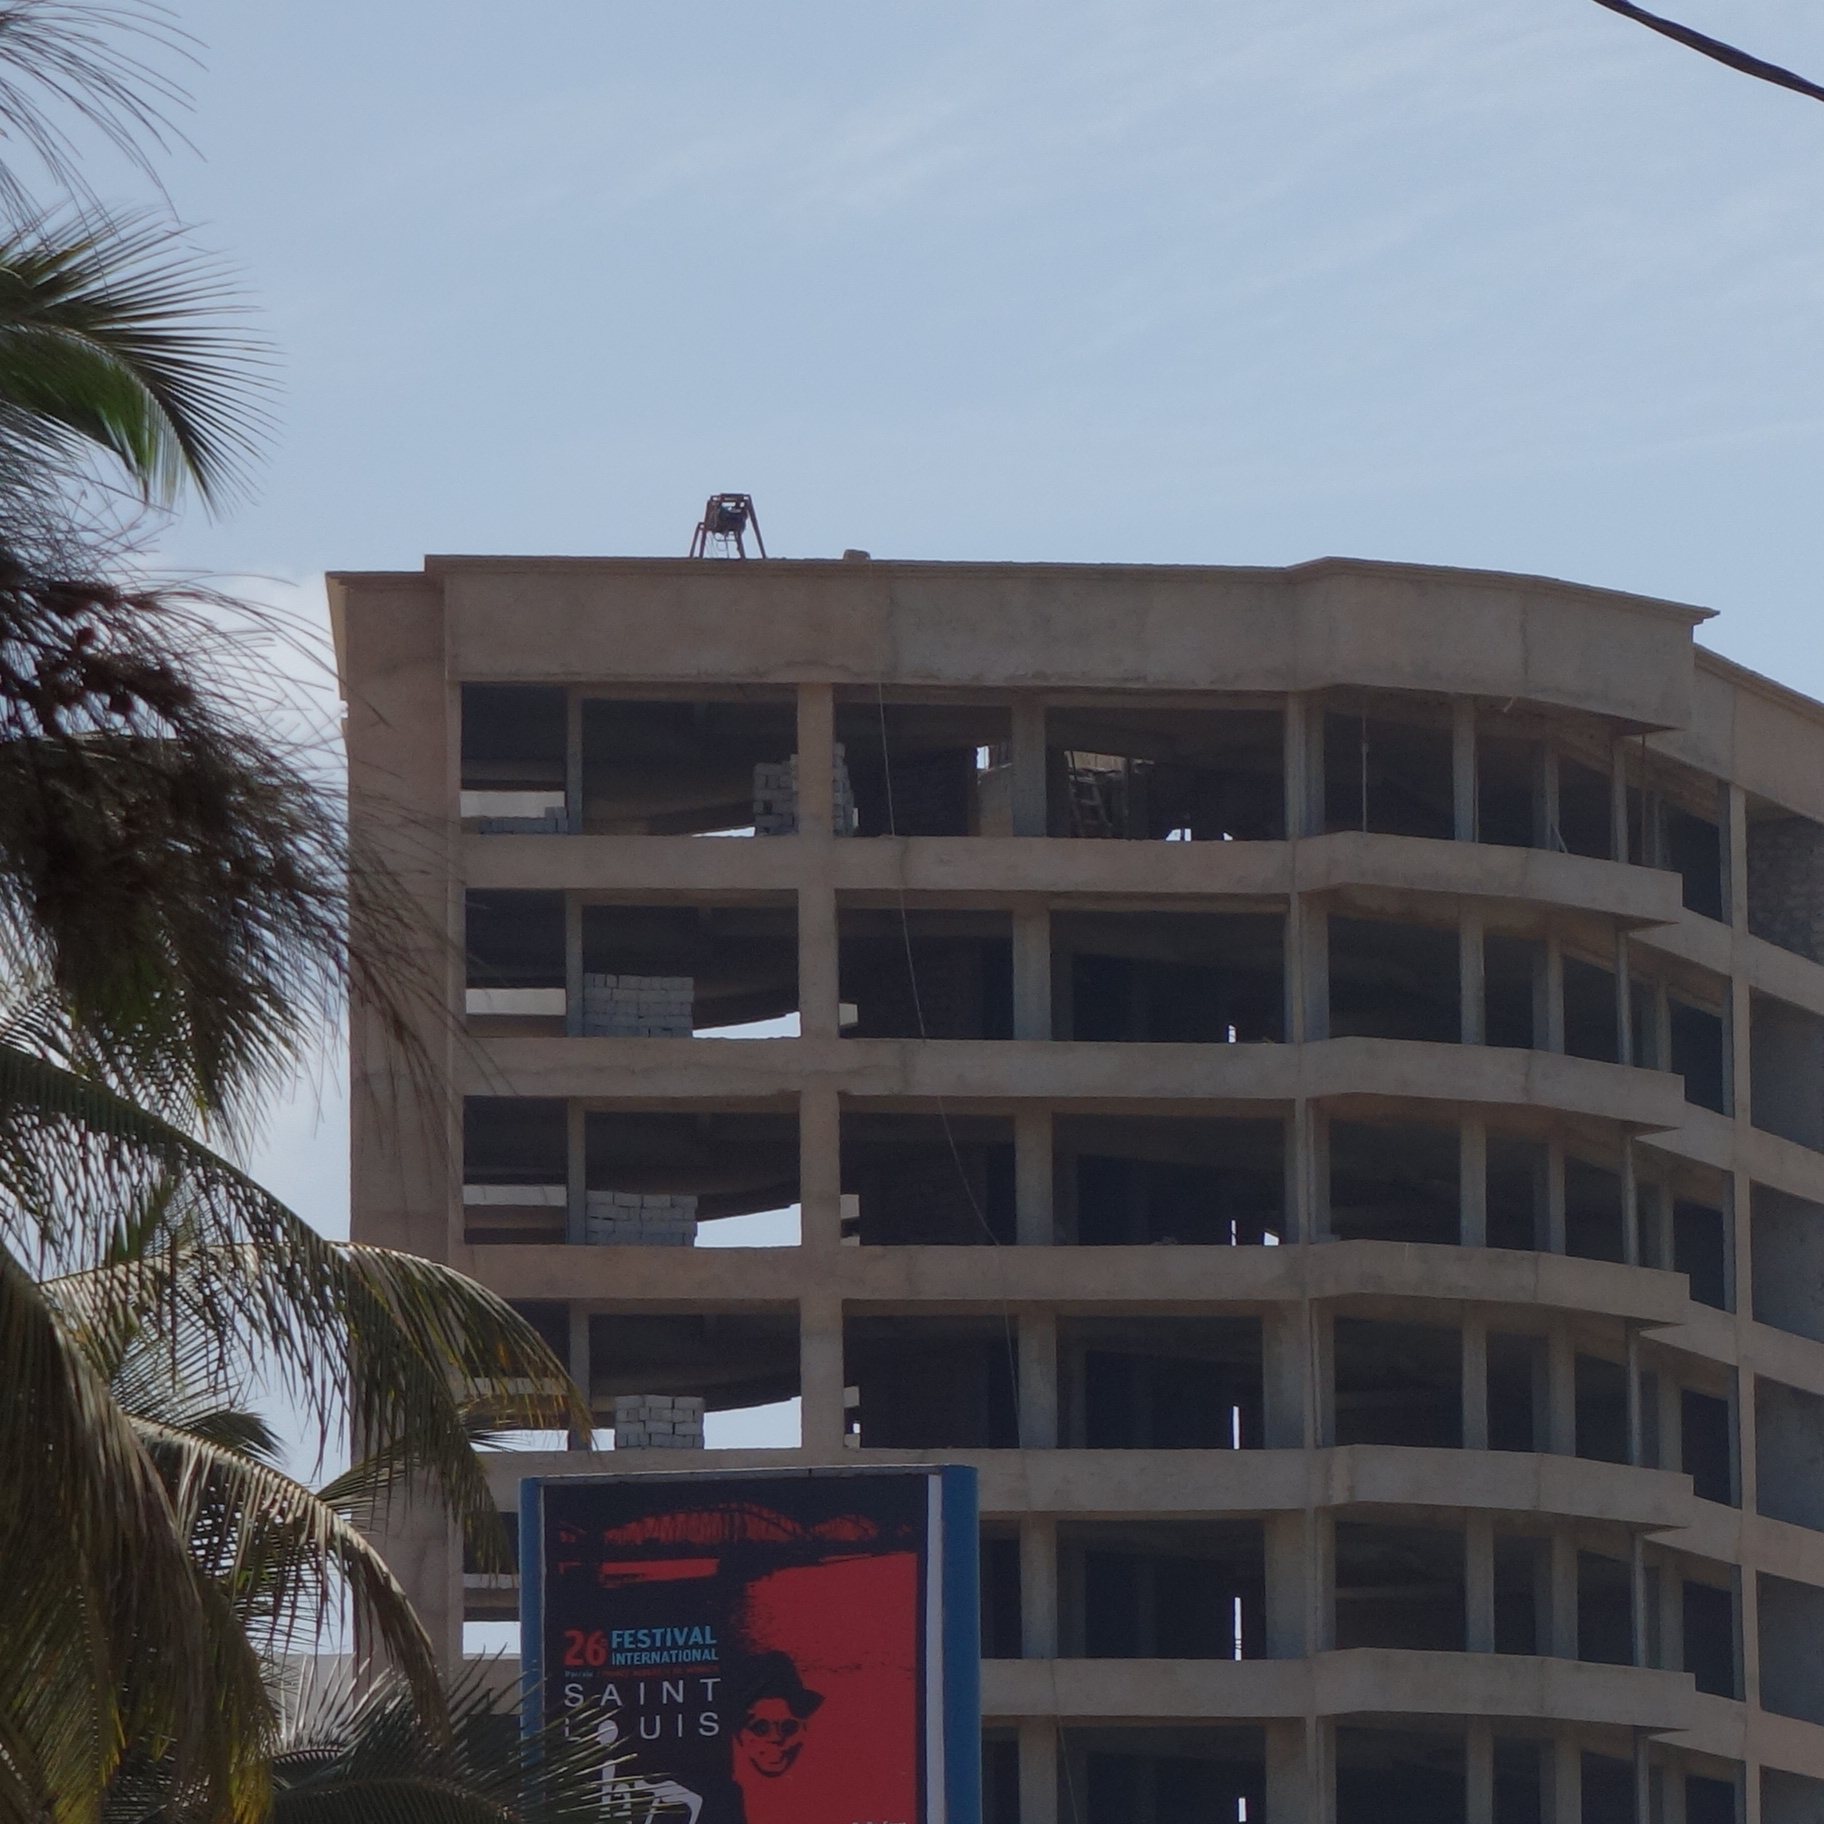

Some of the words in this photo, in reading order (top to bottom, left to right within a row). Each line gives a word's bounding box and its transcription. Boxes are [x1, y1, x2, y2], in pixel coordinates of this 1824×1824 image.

[611, 1626, 717, 1648] FESTIVAL
[612, 1648, 720, 1665] INTERNATIONAL
[564, 1678, 721, 1707] SAINT
